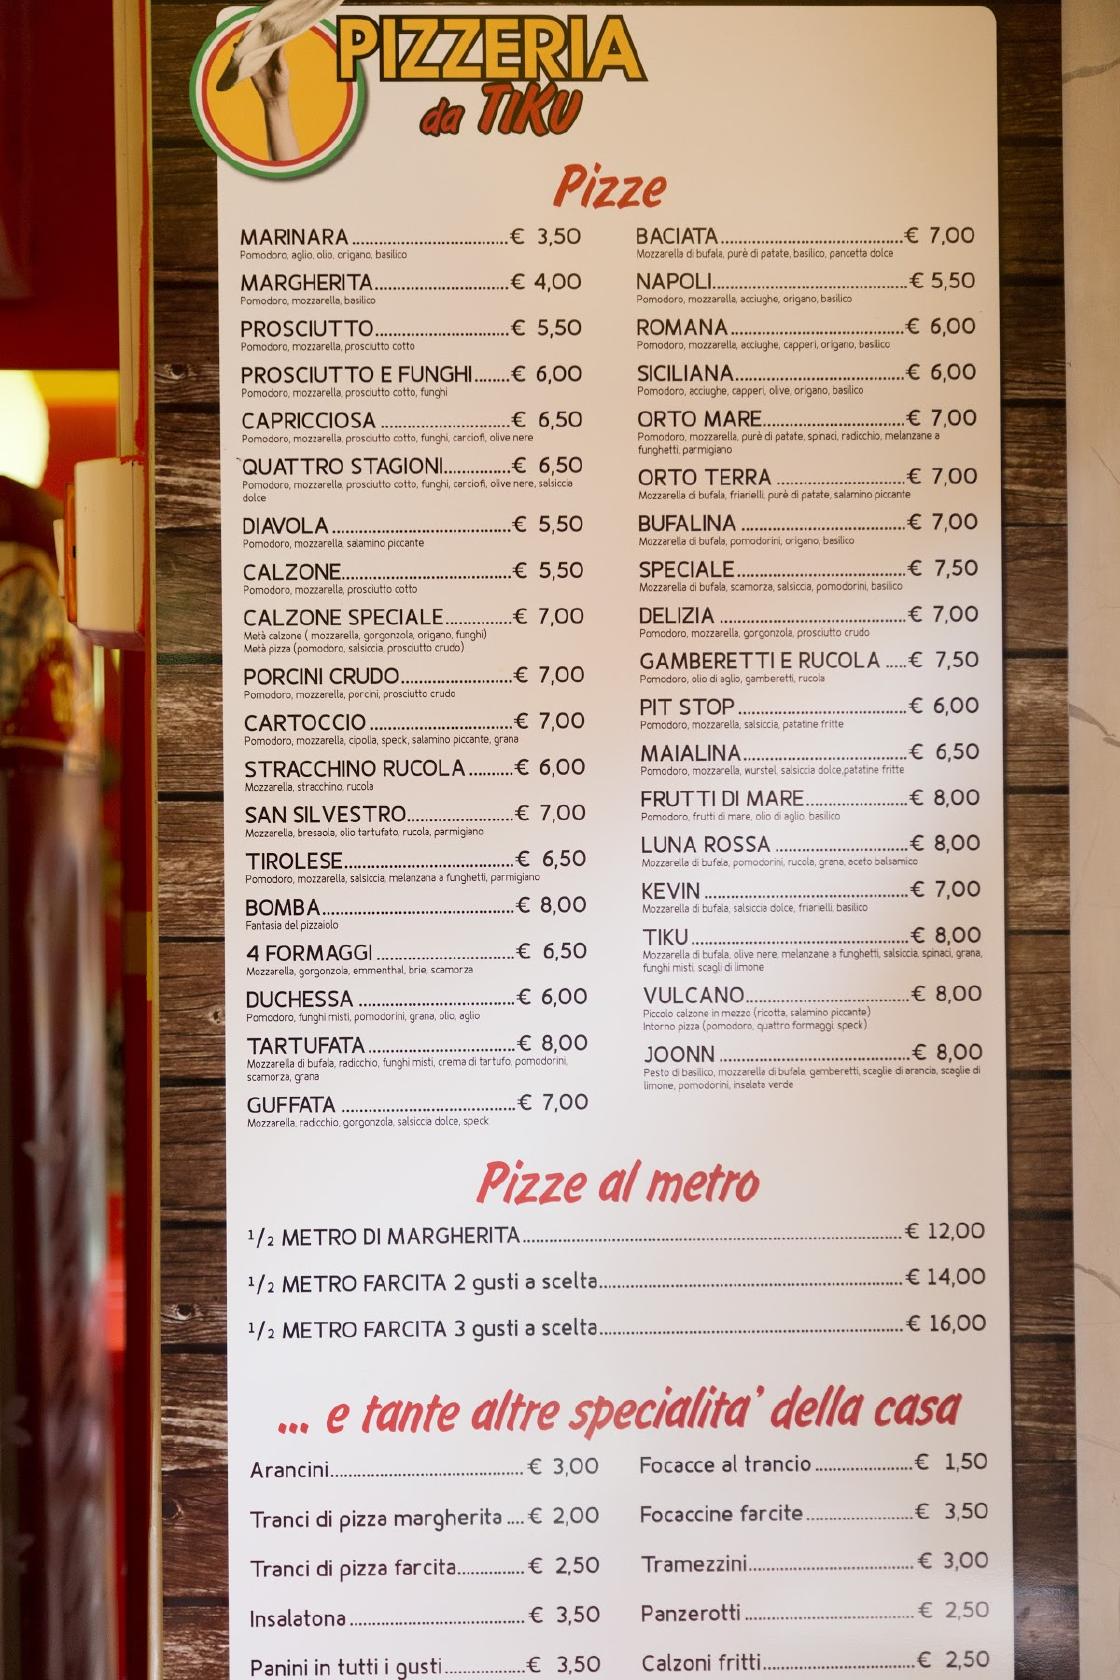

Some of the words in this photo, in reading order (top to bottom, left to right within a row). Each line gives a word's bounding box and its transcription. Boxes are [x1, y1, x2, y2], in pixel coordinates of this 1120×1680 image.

[336, 14, 648, 82] PIZZERIA
[419, 97, 465, 137] da
[477, 81, 583, 137] TIKU
[552, 161, 669, 209] Pizze
[241, 274, 373, 291] MARGHERITA
[534, 273, 582, 293] 4,00
[637, 273, 711, 290] NAPOLI
[932, 272, 975, 291] 5,50
[344, 295, 376, 304] basilico
[820, 293, 852, 302] basilico
[241, 320, 373, 337] PROSCIUTTO
[538, 319, 582, 339] 5,50
[344, 342, 389, 354] prosciutto
[392, 342, 415, 350] cotto
[242, 457, 343, 475] QUATTRO
[351, 457, 442, 474] STAGIONI
[539, 456, 582, 476] 6,50
[244, 563, 341, 581] CALZONE
[540, 561, 583, 581] 5,50
[639, 561, 734, 578] SPECIALE
[935, 559, 978, 579] 7,50
[347, 584, 392, 596] prosciutto
[395, 584, 418, 594] cotto
[640, 582, 687, 592] Mozzarella
[690, 582, 696, 591] di
[872, 581, 903, 590] basilico
[640, 652, 774, 669] GAMBERETTI
[781, 651, 792, 668] E
[799, 651, 880, 668] RUCOLA
[936, 651, 979, 670] 7,50
[692, 674, 707, 683] olio
[710, 674, 717, 683] di
[640, 698, 672, 716] PIT
[680, 698, 734, 715] STOP
[934, 697, 979, 716] 6,00
[244, 714, 366, 731] CARTOCCIO
[540, 712, 584, 732] 7,00
[782, 720, 818, 731] patatine
[821, 720, 844, 728] fritte
[412, 735, 450, 744] salamino
[494, 736, 518, 746] grana
[246, 899, 320, 916] BOMBA
[540, 896, 586, 916] 8,00
[246, 920, 282, 930] Fantasia
[285, 920, 298, 929] del
[300, 919, 338, 932] pizzaiolo
[642, 929, 688, 945] TIKU
[935, 926, 981, 946] 8,00
[246, 990, 353, 1008] DUCHESSA
[542, 988, 587, 1008] 6,00
[643, 986, 744, 1004] VULCANO
[936, 985, 982, 1004] 8,00
[643, 1009, 673, 1018] Piccolo
[676, 1009, 708, 1017] calzone
[790, 1008, 828, 1016] salamino
[831, 1006, 871, 1019] piccante)
[644, 1046, 714, 1063] JOONN
[937, 1043, 982, 1063] 8,00
[476, 1160, 587, 1205] Pizze
[599, 1160, 641, 1202] al
[647, 1164, 761, 1203] metro
[282, 1229, 356, 1246] METRO
[364, 1228, 380, 1245] DI
[388, 1226, 520, 1244] MARGHERITA
[929, 1222, 985, 1241] 12,00
[282, 1275, 357, 1293] METRO
[364, 1274, 446, 1291] FARCITA
[454, 1274, 466, 1291] 2
[472, 1273, 518, 1295] gusti
[526, 1277, 535, 1289] a
[542, 1271, 597, 1289] scelta
[928, 1268, 986, 1288] 14,00
[326, 1404, 350, 1434] e
[361, 1396, 460, 1434] tante
[471, 1389, 560, 1431] altre
[569, 1386, 764, 1440] specialita'
[771, 1385, 864, 1430] della
[874, 1394, 962, 1428] casa
[250, 1461, 328, 1478] Arancini
[554, 1457, 598, 1477] 3,00
[640, 1456, 714, 1474] Focacce
[722, 1454, 737, 1472] al
[745, 1455, 811, 1472] trancio
[946, 1453, 987, 1472] 1,50
[250, 1511, 309, 1528] Tranci
[316, 1510, 332, 1527] di
[340, 1510, 386, 1531] pizza
[394, 1508, 502, 1531] margherita
[554, 1506, 599, 1526] 2,00
[641, 1555, 746, 1573] Tramezzini
[944, 1552, 988, 1572] 3,00
[250, 1608, 346, 1627] Insalatona
[556, 1606, 600, 1626] 3,50
[642, 1653, 711, 1672] Calzoni
[718, 1653, 760, 1671] fritti
[946, 1650, 990, 1671] 2,50
